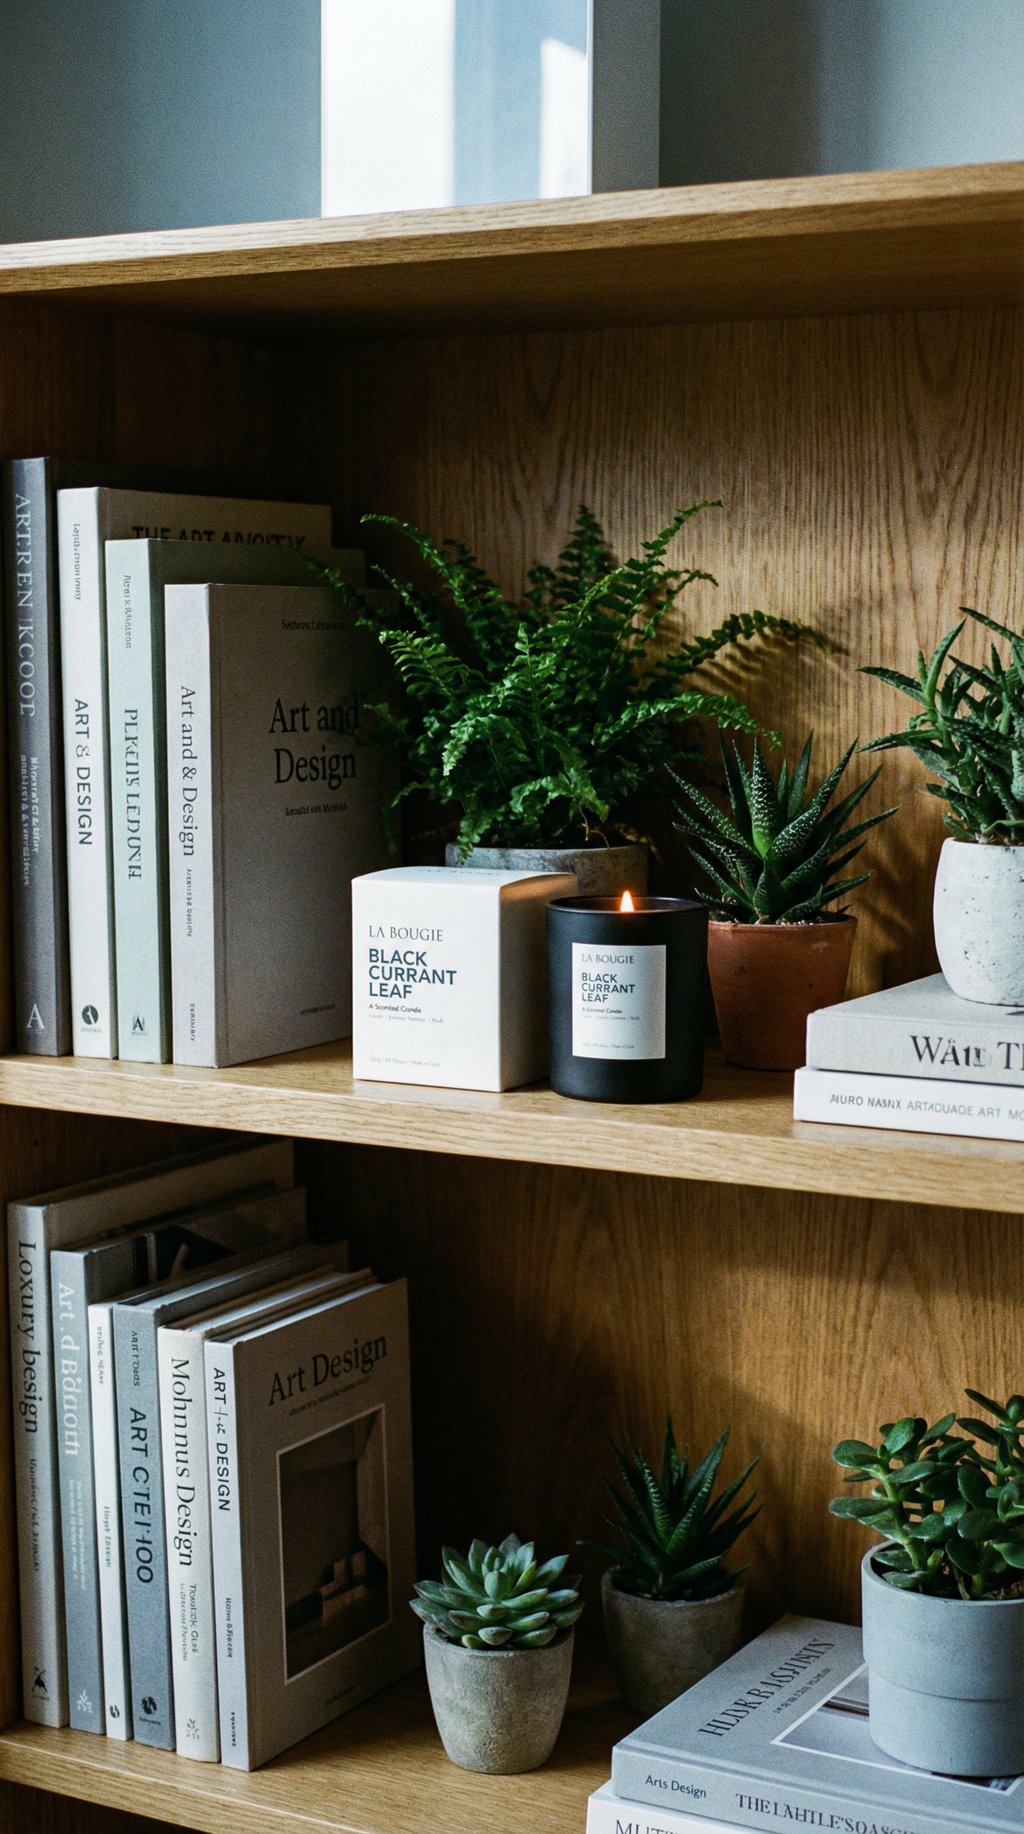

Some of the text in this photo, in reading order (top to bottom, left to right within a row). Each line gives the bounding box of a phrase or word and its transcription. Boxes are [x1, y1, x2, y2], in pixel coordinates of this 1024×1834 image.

[181, 685, 197, 718] Art
[268, 691, 359, 734] Art and
[181, 723, 199, 760] and
[74, 698, 93, 846] ART & DESIGN
[182, 766, 197, 781] &
[273, 745, 358, 791] Design
[178, 787, 199, 857] Design
[369, 925, 443, 942] LA BOUGIE
[368, 947, 428, 967] BLACK
[581, 953, 635, 964] LA BOUGIE
[368, 965, 458, 985] CURRANT
[369, 981, 413, 999] LEAF
[581, 972, 618, 984] BLACK
[581, 982, 636, 994] CURRANT
[581, 992, 609, 1003] LEAF
[59, 1282, 76, 1321] Art
[213, 1367, 227, 1405] ART
[268, 1366, 306, 1407] Art
[311, 1335, 388, 1387] Design
[129, 1407, 149, 1457] ART
[216, 1442, 231, 1512] DESIGN
[174, 1484, 198, 1567] Design
[645, 1774, 668, 1790] Arts
[671, 1780, 708, 1800] Design
